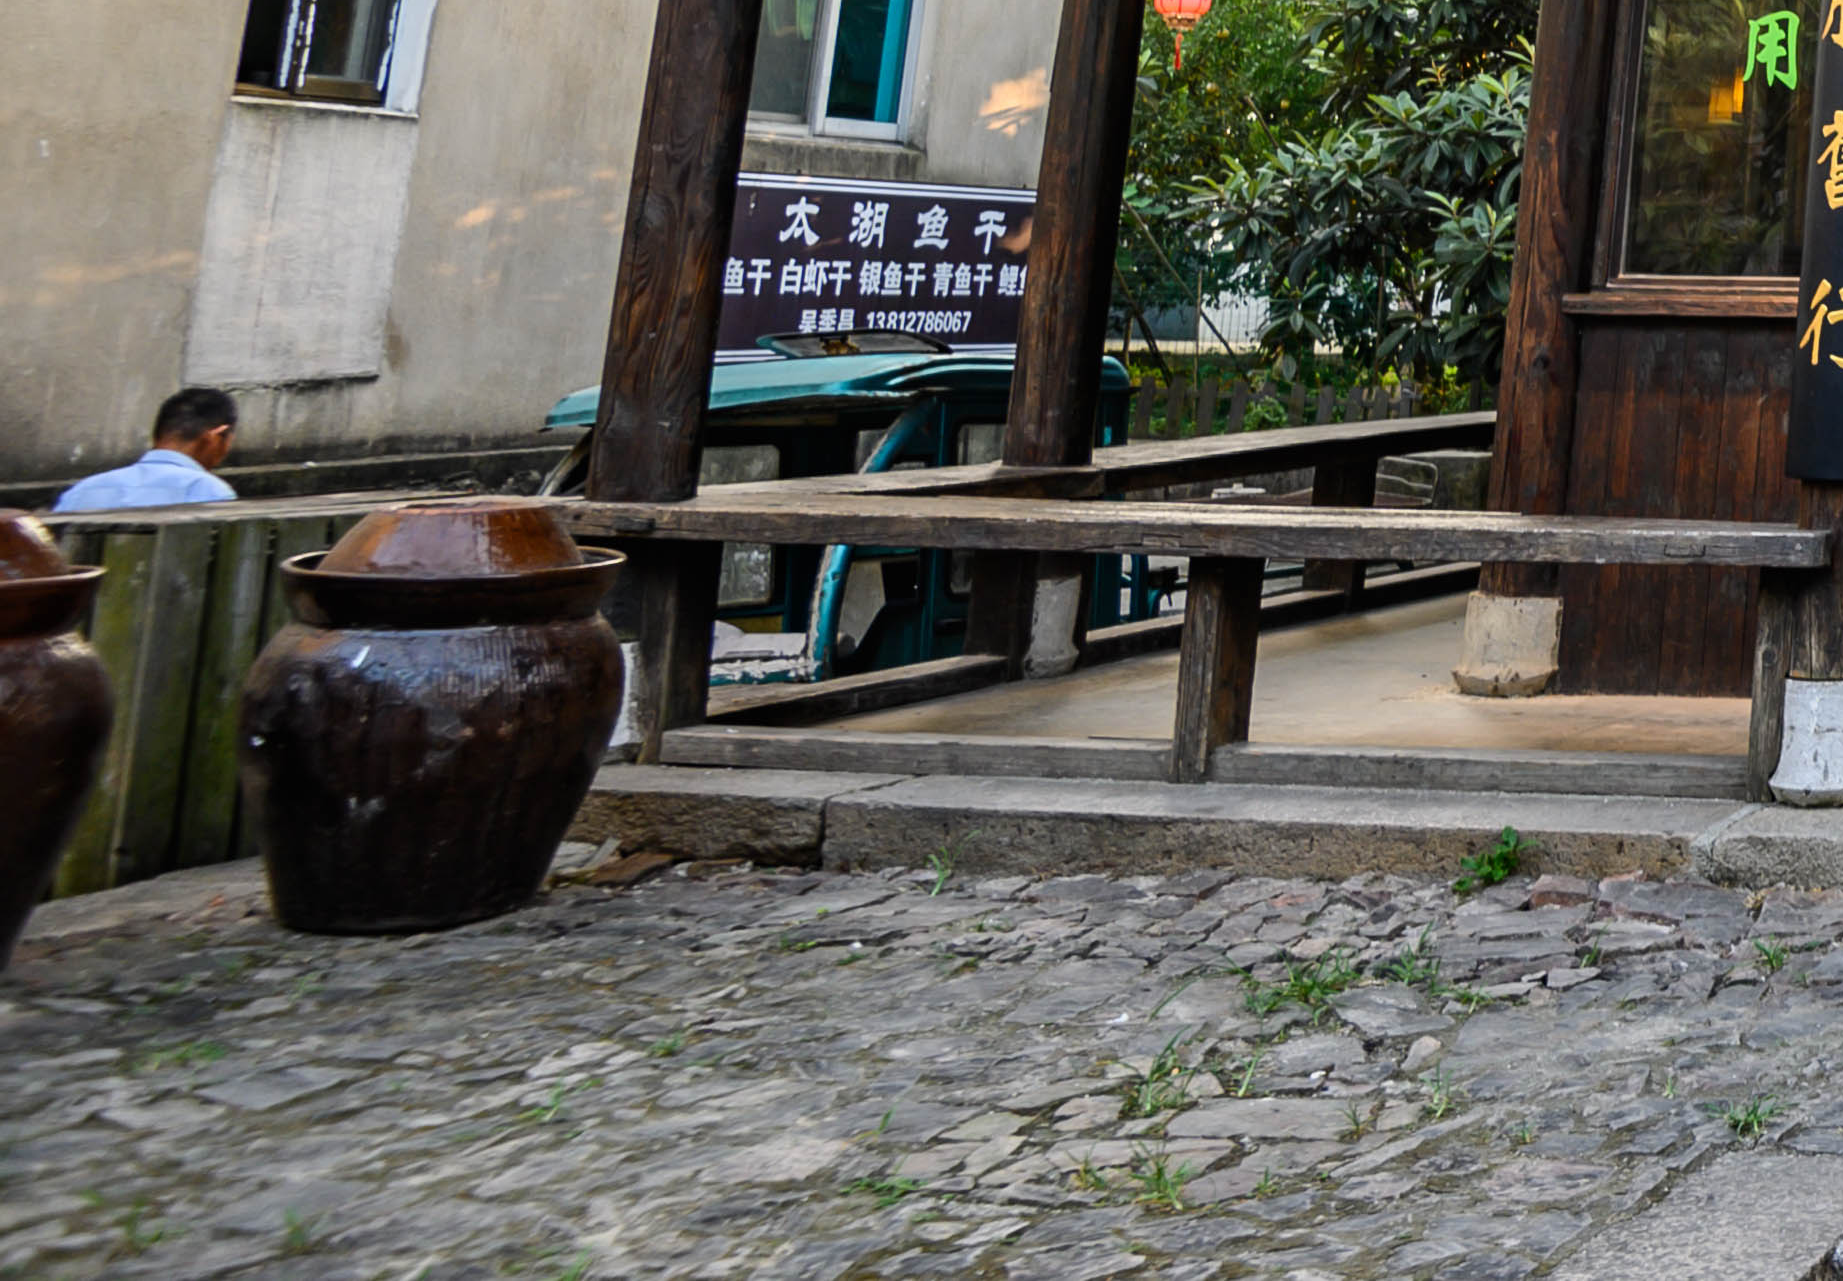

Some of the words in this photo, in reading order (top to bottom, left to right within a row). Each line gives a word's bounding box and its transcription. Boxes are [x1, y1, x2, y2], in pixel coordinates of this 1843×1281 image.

[779, 195, 1007, 255] 太湖鱼干
[722, 256, 772, 296] 鱼干
[780, 257, 853, 297] 白虾干
[859, 259, 927, 297] 银鱼干
[932, 261, 994, 297] 青鱼干
[866, 310, 972, 333] 13812786067
